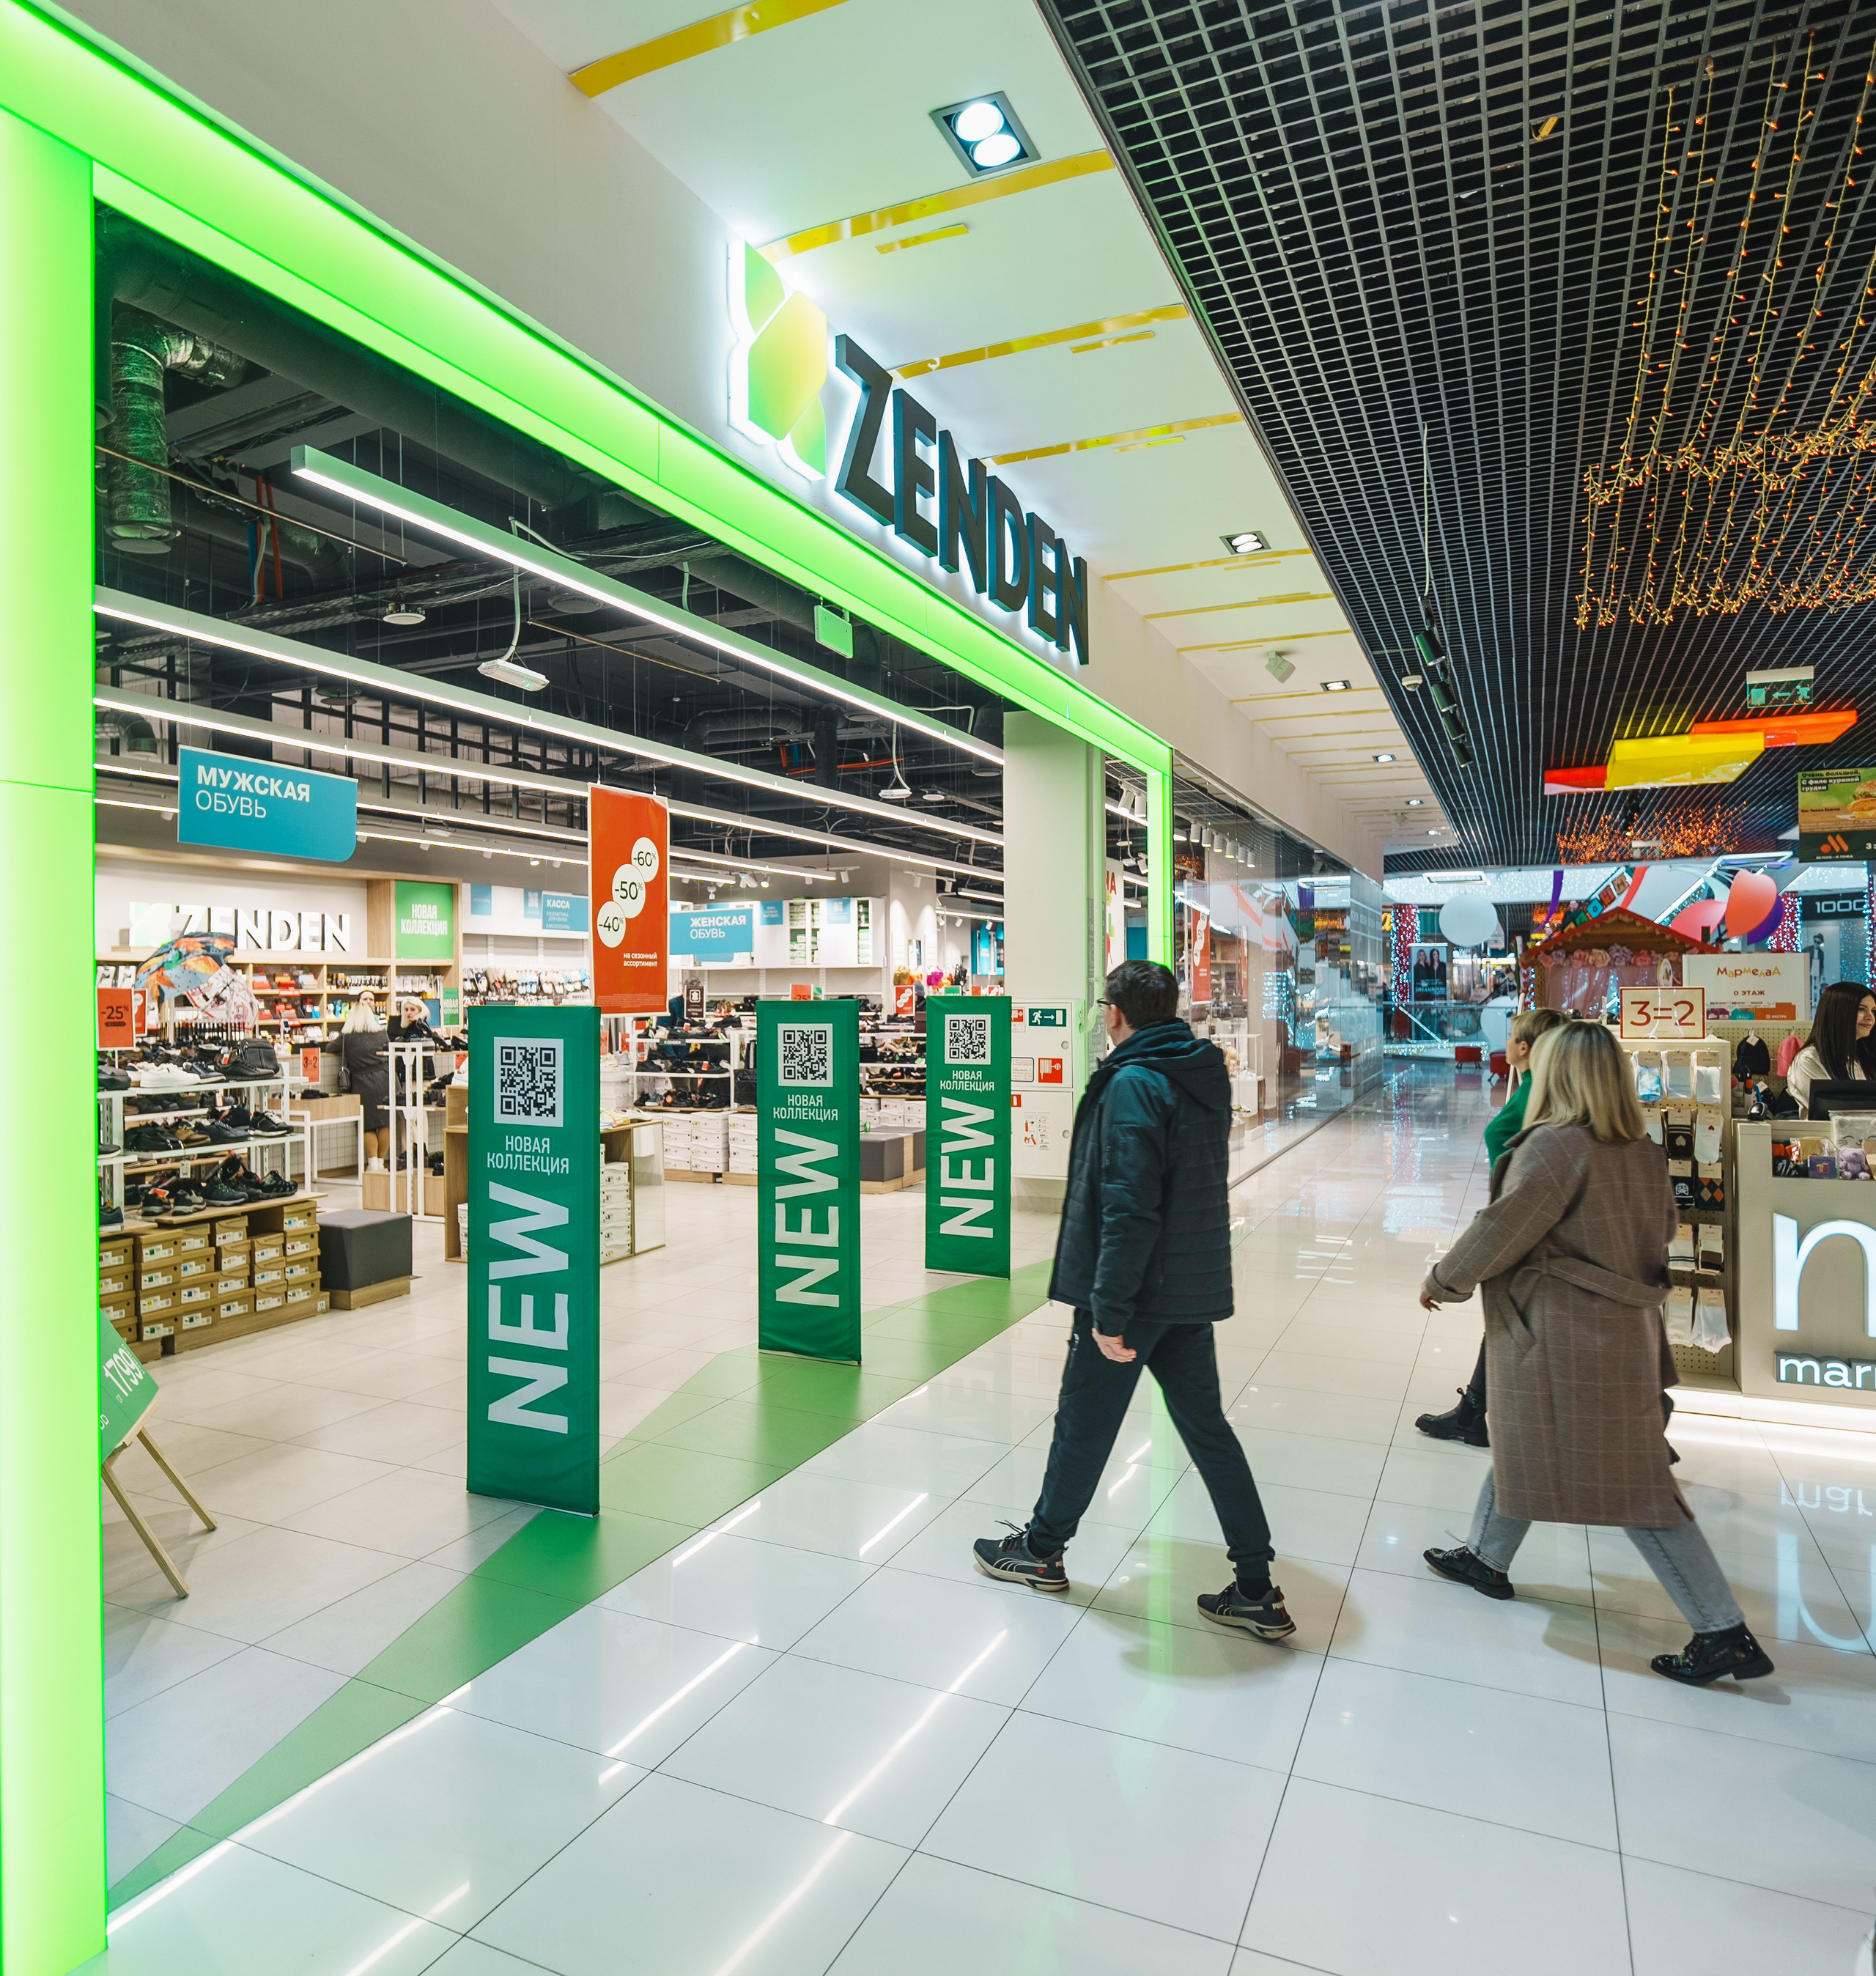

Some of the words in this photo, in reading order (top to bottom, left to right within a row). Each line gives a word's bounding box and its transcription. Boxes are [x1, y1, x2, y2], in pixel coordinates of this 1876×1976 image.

[835, 333, 1090, 665] ZENDEN
[197, 765, 311, 803] МУЖСКАЯ
[195, 789, 267, 819] ОБУВЬ
[633, 851, 657, 867] -60%
[615, 881, 643, 900] -50%
[411, 904, 437, 920] НОВАЯ
[547, 899, 570, 910] КАССА
[177, 904, 350, 953] ZENDEN
[400, 919, 448, 937] КОЛЛЕКЦИЯ
[599, 916, 624, 932] -40%
[690, 915, 746, 927] ЖЕНСКАЯ
[690, 928, 725, 939] ОБУВЬ
[101, 1005, 129, 1020] -25%
[1630, 1000, 1696, 1027] 3=2
[303, 1056, 317, 1068] 3=2
[952, 1070, 983, 1080] НОВАЯ
[939, 1080, 994, 1092] КОЛЛЕКЦИЯ
[788, 1094, 823, 1107] НОВАЯ
[773, 1107, 838, 1122] КОЛЛЕКЦИЯ
[506, 1135, 550, 1154] НОВАЯ
[487, 1152, 569, 1175] КОЛЛЕКЦИЯ
[939, 1096, 994, 1239] NEW
[775, 1128, 840, 1308] NEW
[488, 1181, 569, 1434] NEW
[103, 1348, 143, 1397] 1799
[1779, 1358, 1876, 1389] mar
